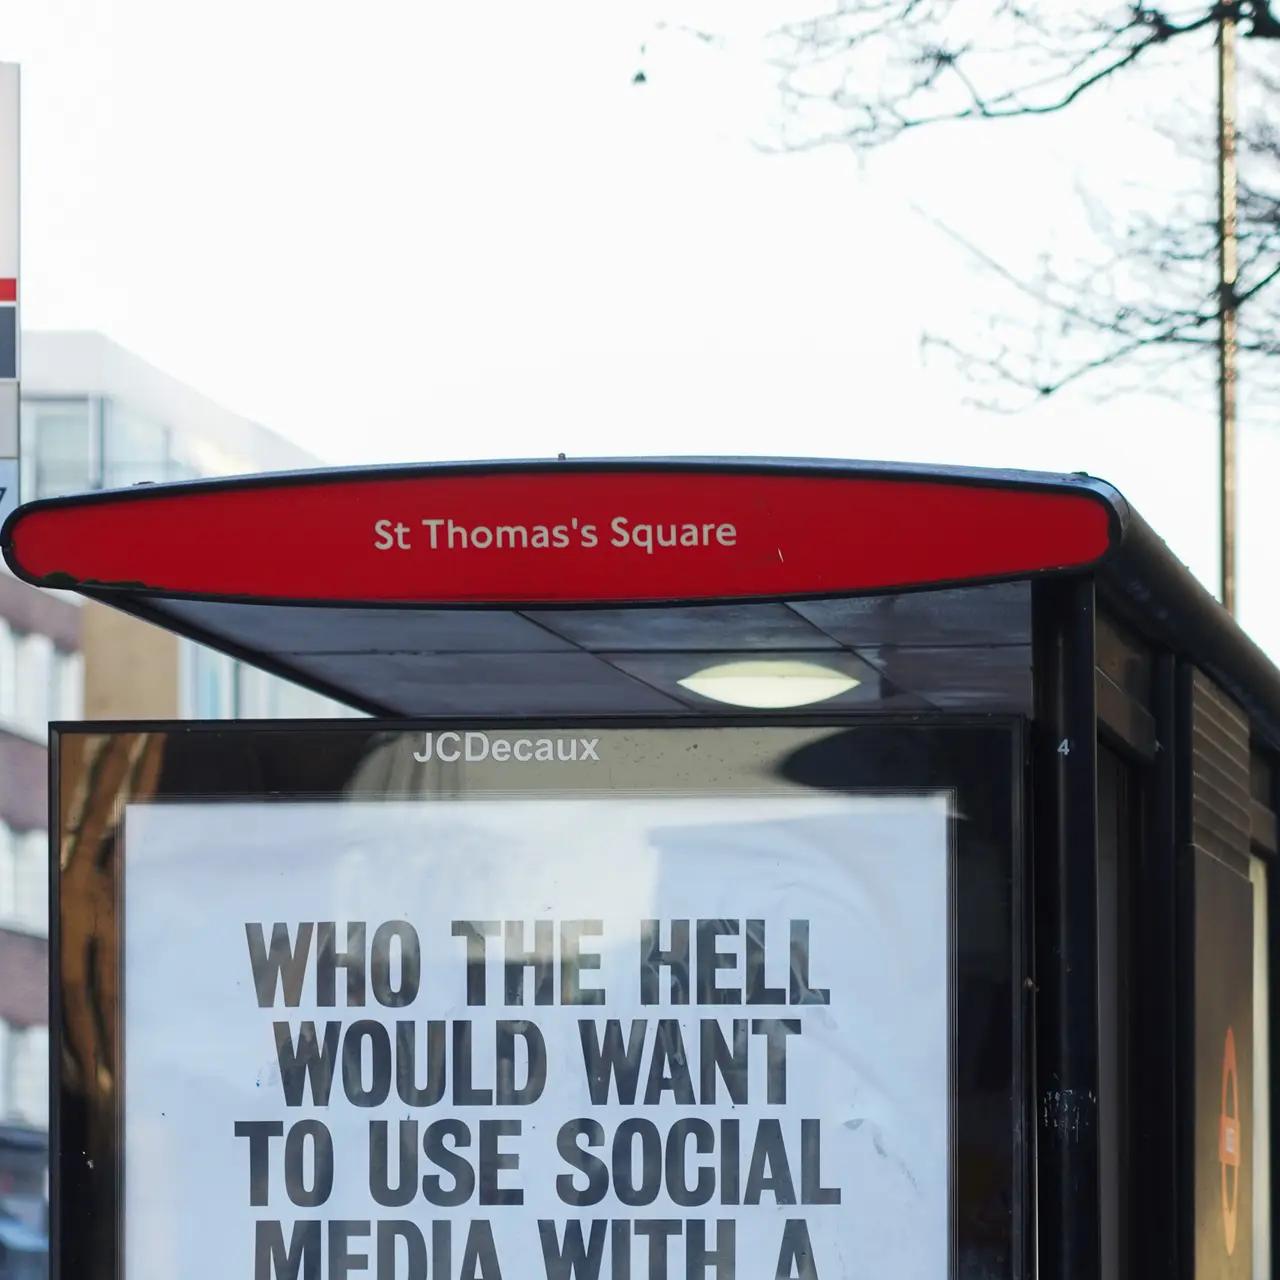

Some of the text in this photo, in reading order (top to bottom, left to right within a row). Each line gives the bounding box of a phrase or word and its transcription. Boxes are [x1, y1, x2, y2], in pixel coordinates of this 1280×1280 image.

[374, 516, 737, 555] St Thomas's Square
[413, 731, 600, 762] JCDecaux
[1057, 738, 1070, 756] 4
[245, 919, 831, 1008] WHO THE HELL
[272, 1018, 802, 1107] WOULD WANT
[234, 1118, 842, 1207] TO USE SOCIAL
